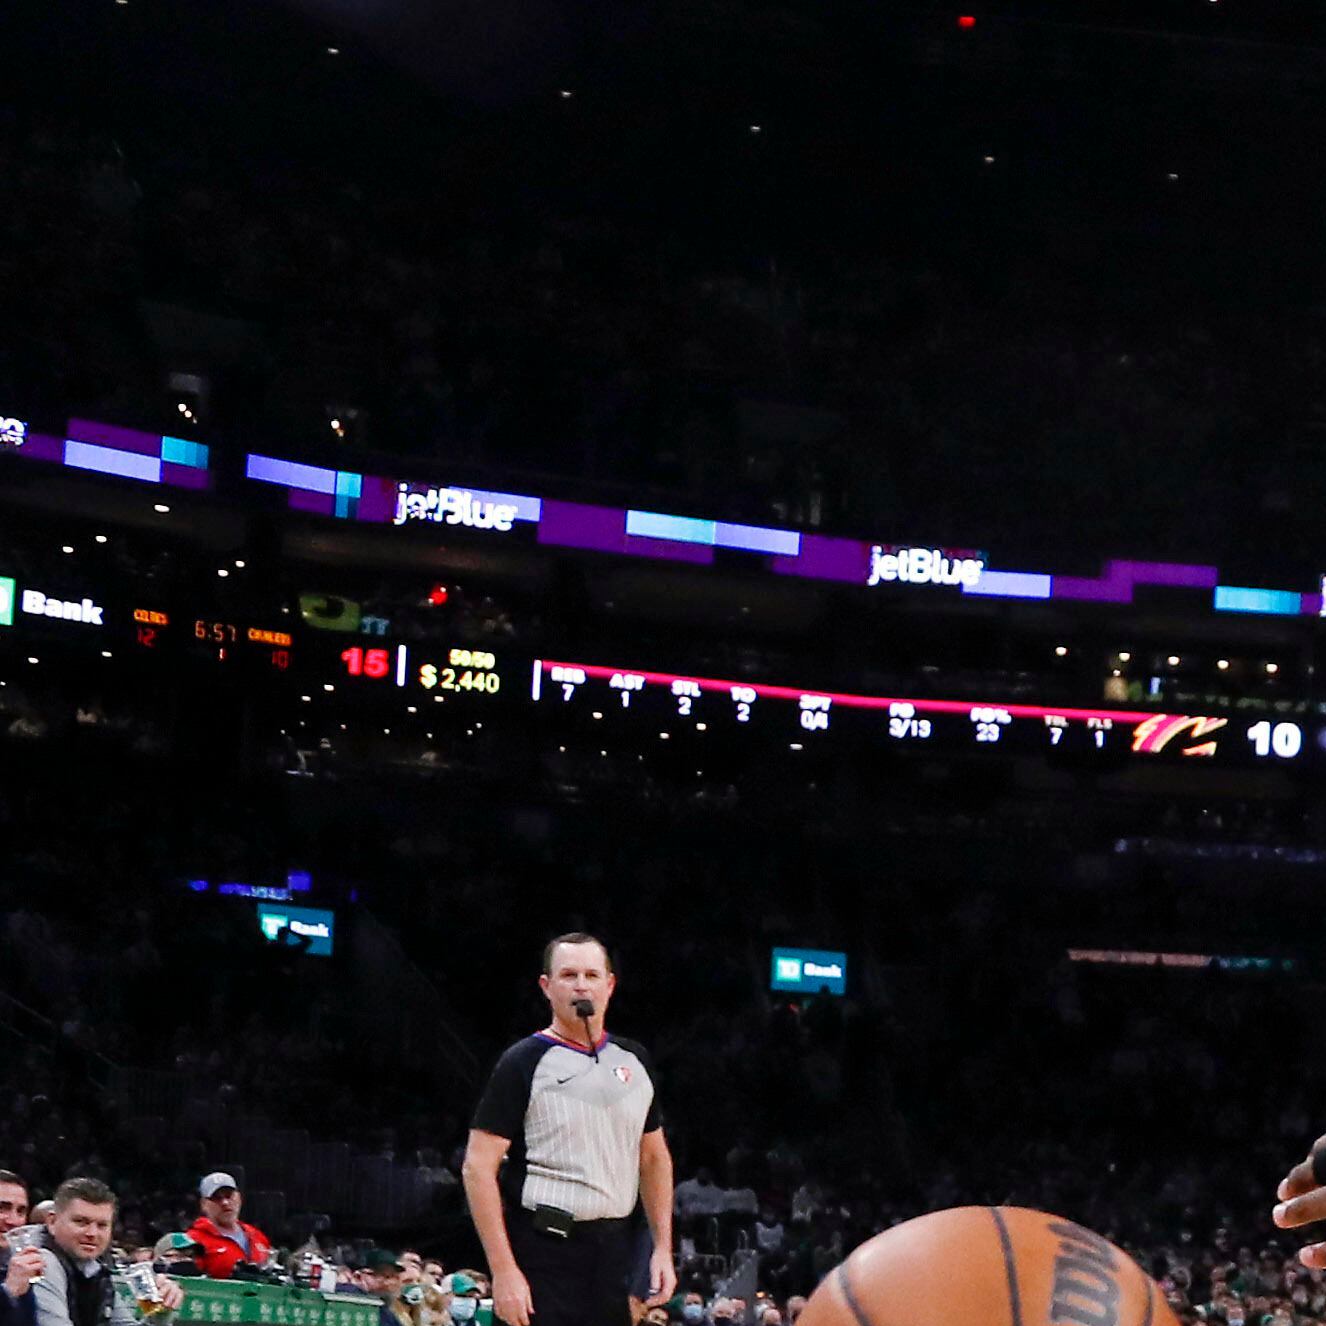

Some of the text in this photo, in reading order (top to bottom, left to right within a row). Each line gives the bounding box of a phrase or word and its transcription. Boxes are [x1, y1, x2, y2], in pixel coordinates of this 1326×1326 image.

[867, 545, 982, 586] jetBlue
[22, 589, 103, 625] Bank
[194, 619, 237, 642] 6:57
[341, 647, 389, 679] 15
[420, 664, 500, 693] $ 2,440
[609, 673, 645, 690] AST
[561, 684, 574, 701] 7
[620, 690, 630, 707] 1
[677, 696, 692, 715] 2
[737, 702, 750, 722] 2
[889, 718, 931, 738] 3/13
[976, 723, 1000, 742] 23
[1050, 727, 1063, 745] 7
[1095, 730, 1104, 748] 1
[1247, 721, 1302, 758] 10
